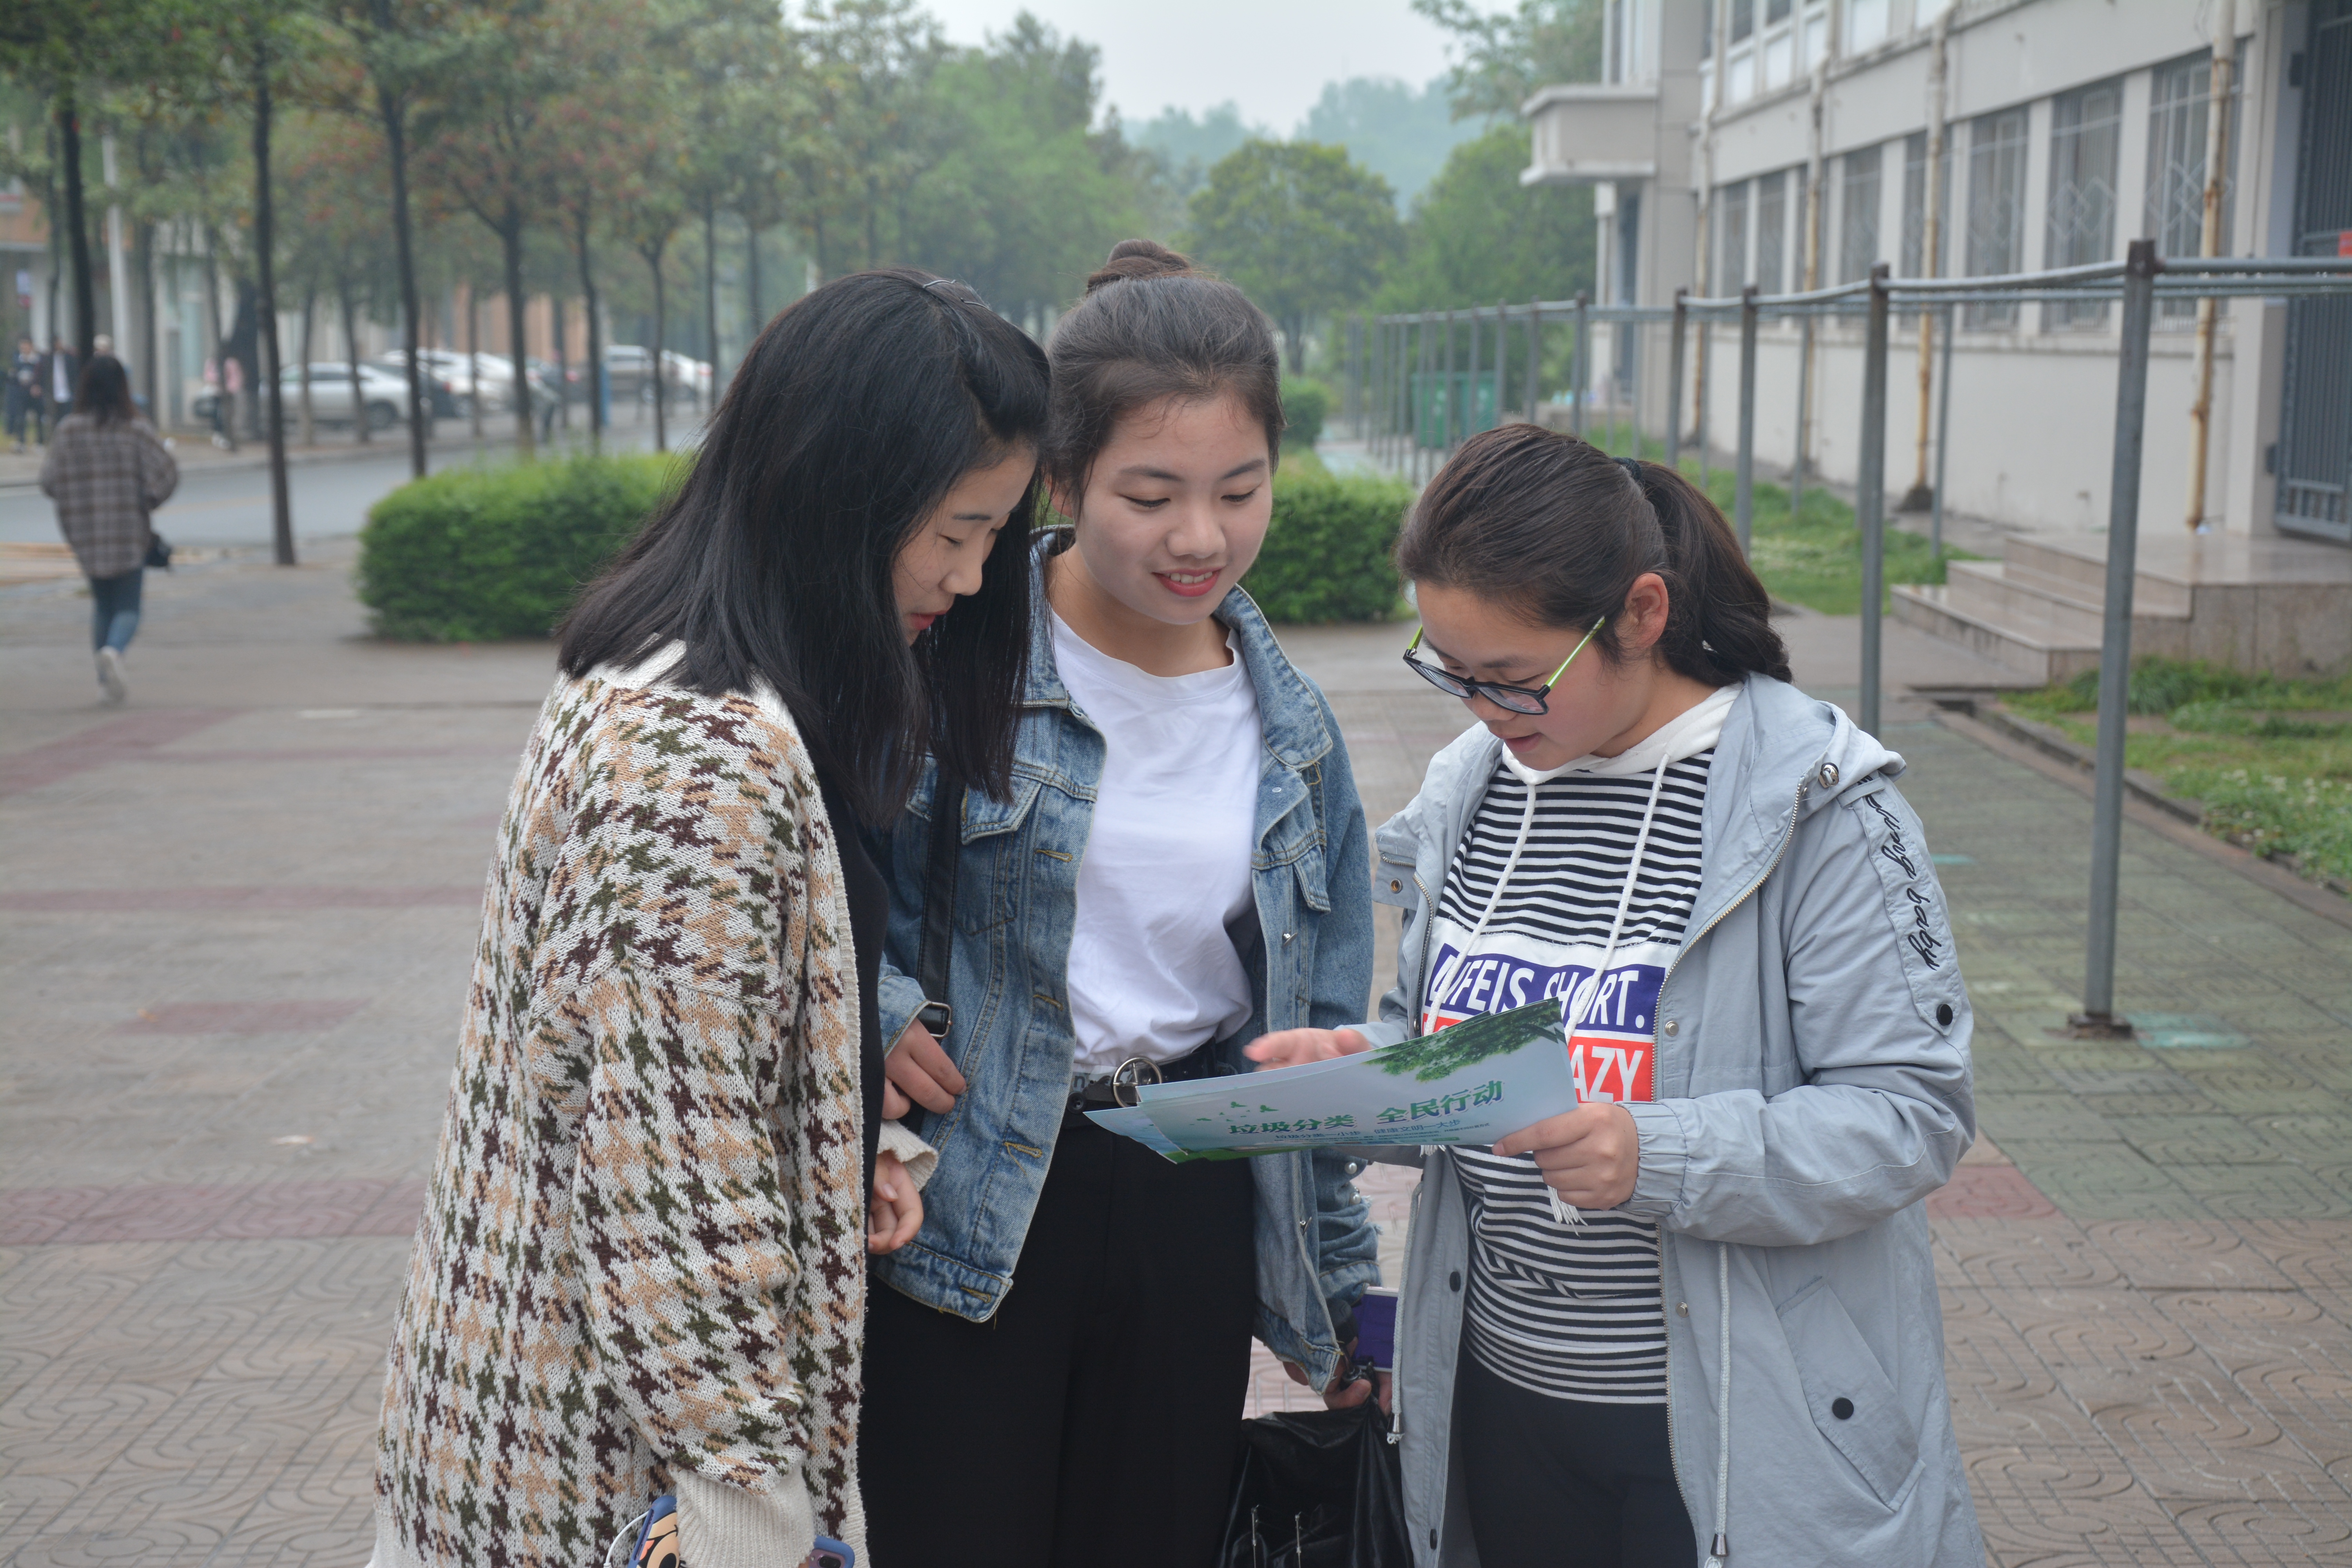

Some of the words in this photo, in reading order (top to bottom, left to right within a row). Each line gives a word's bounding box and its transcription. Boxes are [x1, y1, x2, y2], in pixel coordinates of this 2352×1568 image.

[1906, 887, 1942, 971] baby
[1570, 1044, 1644, 1104] AZY
[1228, 1114, 1356, 1134] 垃圾分类
[1376, 1080, 1503, 1124] 全民行动
[1374, 1120, 1461, 1134] 健康文明一大步
